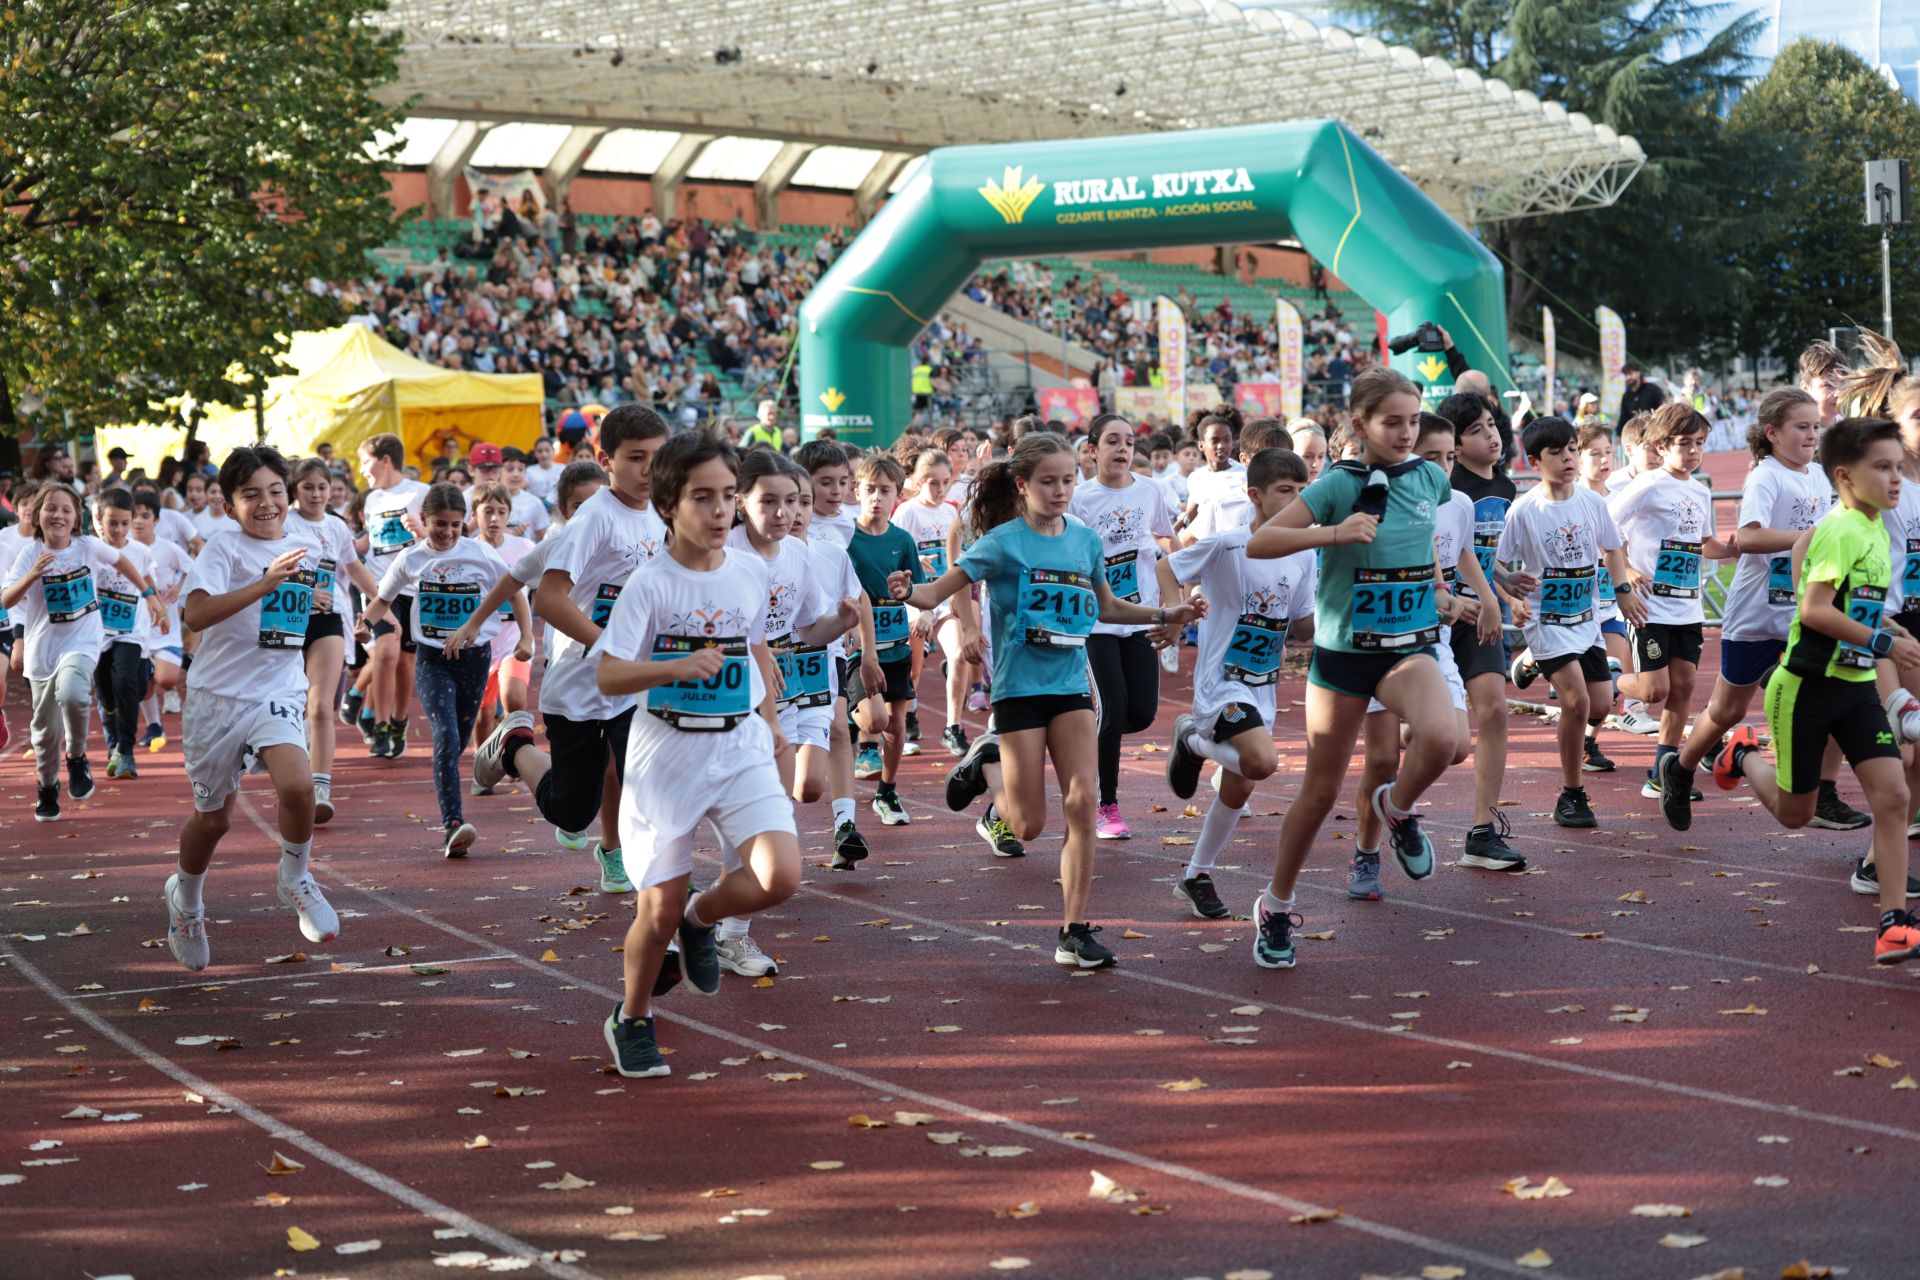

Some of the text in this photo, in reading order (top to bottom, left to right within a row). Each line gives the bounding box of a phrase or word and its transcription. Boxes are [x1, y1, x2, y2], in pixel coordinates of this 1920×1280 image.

[1053, 167, 1256, 206] RURAL KUTXA
[1056, 210, 1106, 225] GIZARTE
[1107, 207, 1157, 221] EKINTZA
[1164, 202, 1211, 217] ACCIÓN
[1212, 199, 1257, 214] SOCIAL
[830, 414, 874, 427] KUTXA
[1657, 554, 1697, 574] 2269
[46, 579, 88, 602] 2211
[1355, 584, 1429, 614] 2167
[1544, 581, 1592, 601] 2304
[421, 597, 475, 614] 2280
[1029, 589, 1095, 618] 2116
[1056, 616, 1073, 625] ANE
[1377, 615, 1412, 624] ANDREA
[657, 662, 742, 690] 00
[680, 692, 717, 701] JULEN
